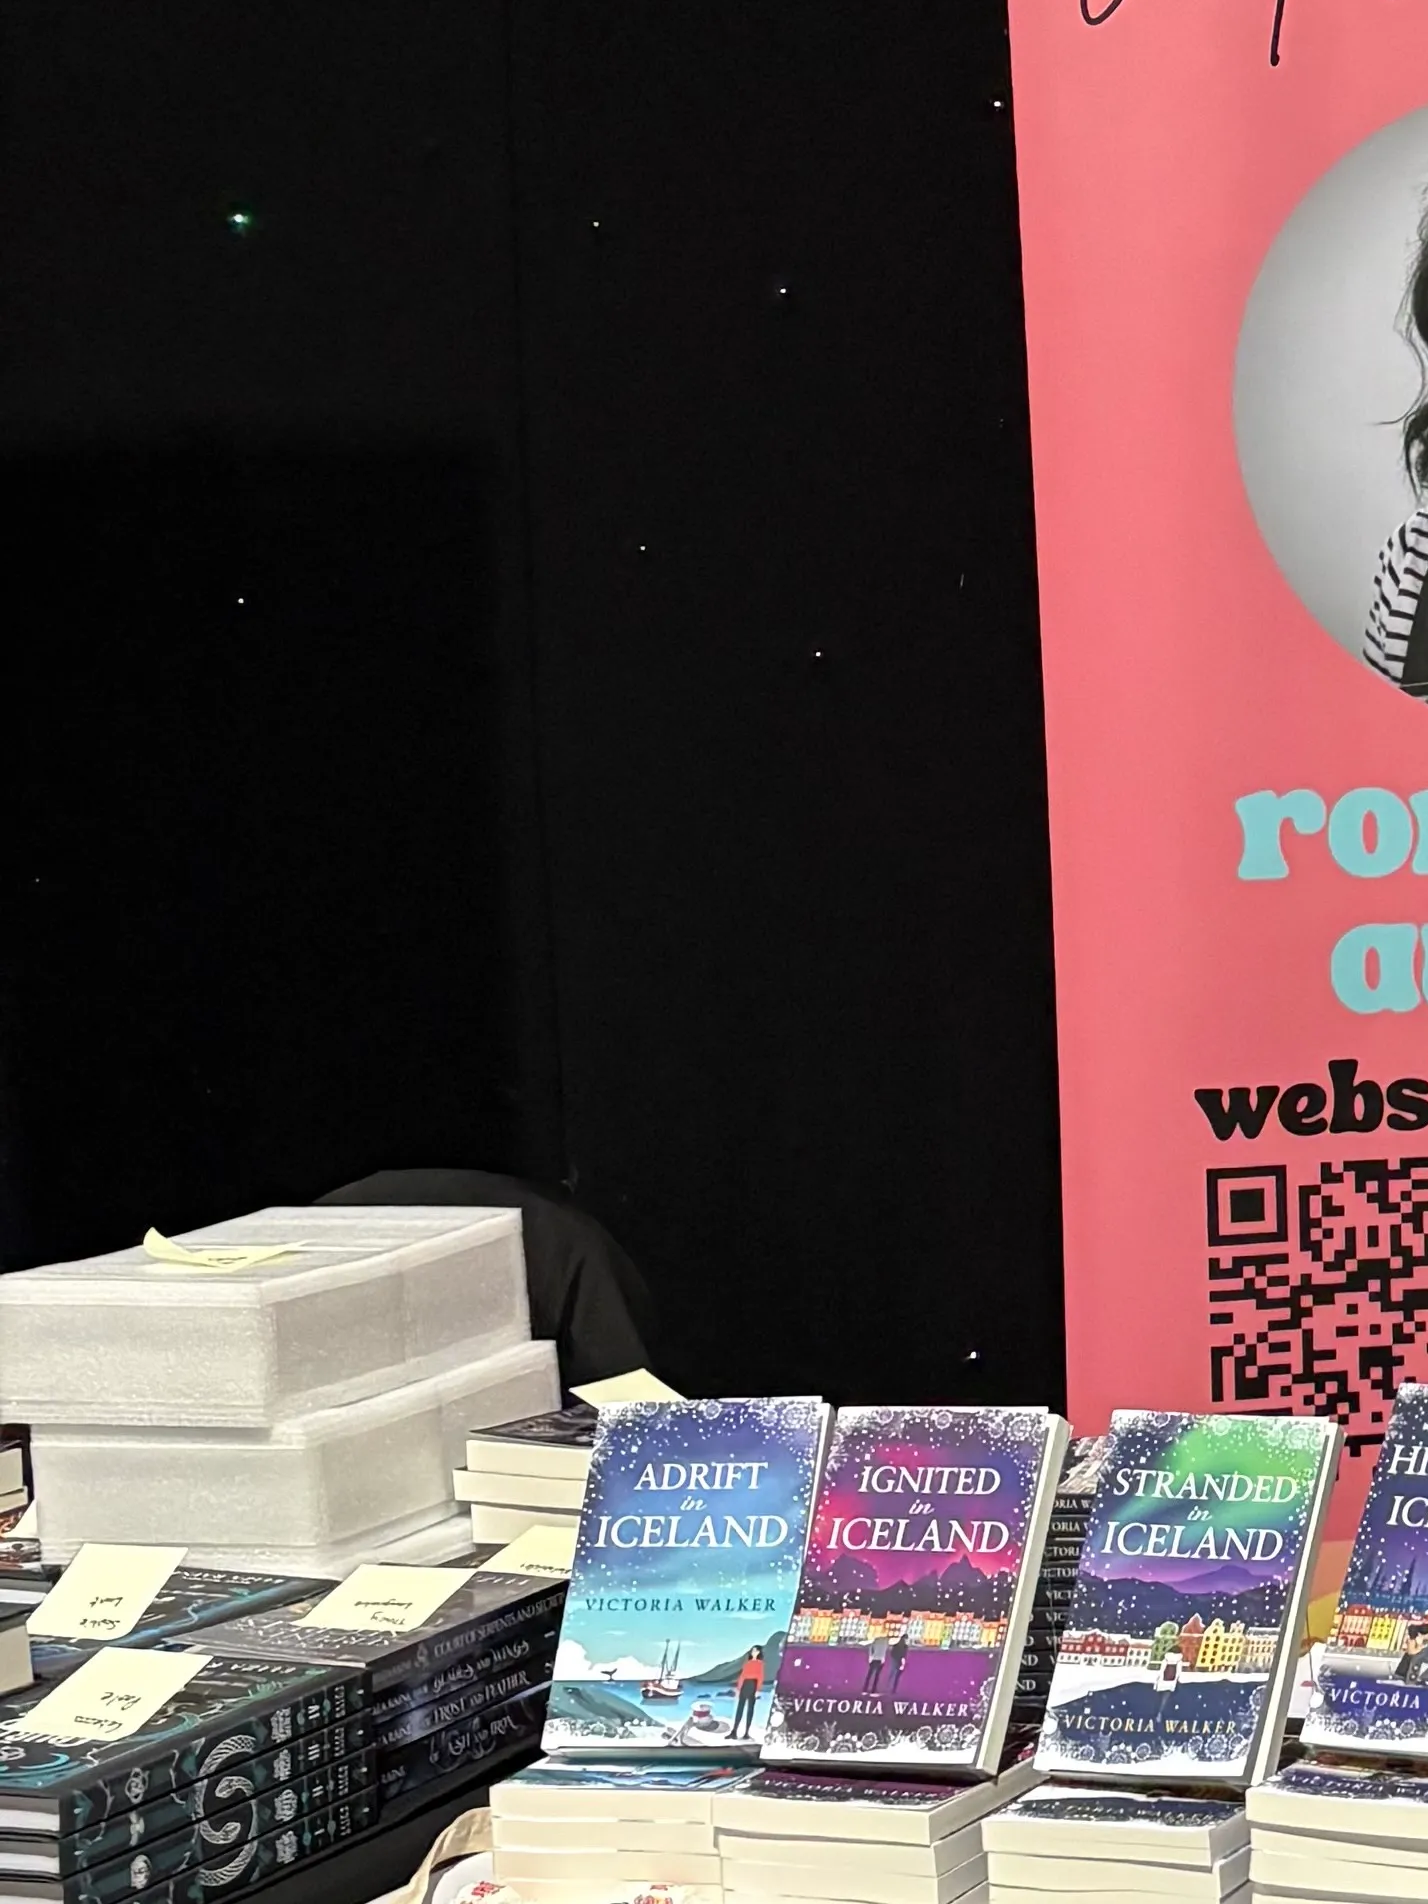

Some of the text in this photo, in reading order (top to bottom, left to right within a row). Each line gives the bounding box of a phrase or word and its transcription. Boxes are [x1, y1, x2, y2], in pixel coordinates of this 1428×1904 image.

[634, 1462, 768, 1493] ADRIFT
[858, 1466, 1001, 1496] IGNITED
[1113, 1468, 1297, 1504] STRANDED
[681, 1495, 706, 1512] in
[909, 1499, 934, 1515] in
[1187, 1505, 1212, 1521] in
[595, 1515, 789, 1549] ICELAND
[827, 1518, 1009, 1553] ICELAND
[1100, 1522, 1283, 1561] ICELAND
[585, 1597, 777, 1613] VICTORIA WALKER
[794, 1699, 969, 1717] VICTORIA WALKER
[1330, 1687, 1420, 1710] VICTORIA
[1060, 1715, 1238, 1735] VICTORIA WALKER
